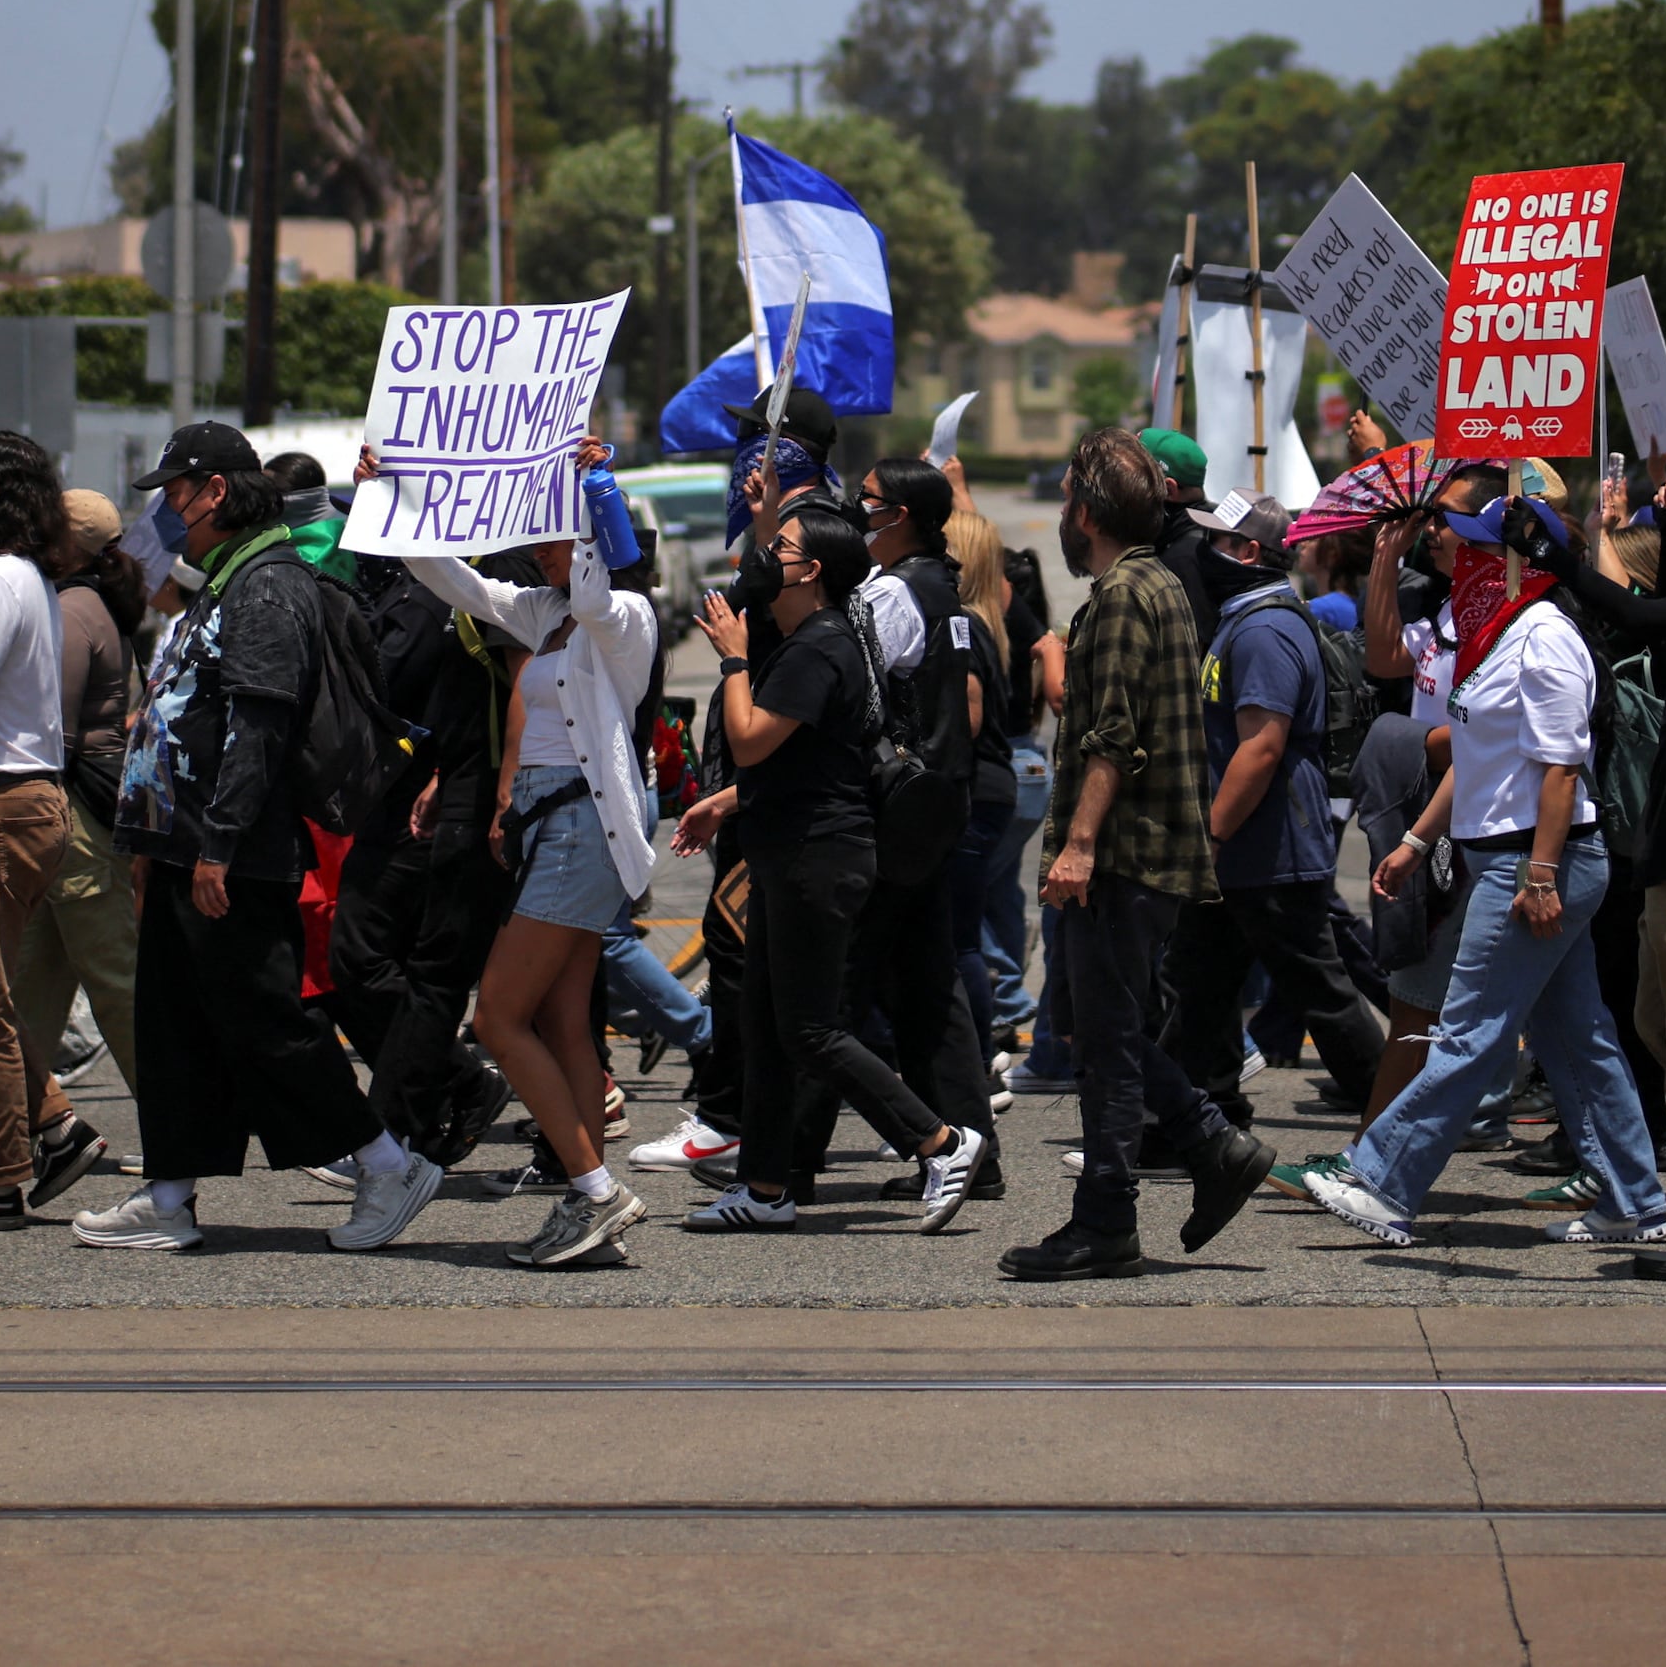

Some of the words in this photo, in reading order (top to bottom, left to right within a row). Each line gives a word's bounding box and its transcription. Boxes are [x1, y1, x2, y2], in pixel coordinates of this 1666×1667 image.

[1472, 197, 1510, 222] NO
[1520, 192, 1574, 219] ONE
[1581, 189, 1609, 215] IS
[1277, 264, 1319, 305] We
[1311, 217, 1354, 274] need
[1460, 220, 1603, 265] ILLEGAL
[1310, 265, 1374, 339] leaders
[1365, 227, 1397, 271] not
[1355, 307, 1391, 346] love
[1383, 264, 1430, 311] with
[1506, 272, 1545, 297] ON
[391, 309, 520, 374] STOP
[533, 300, 615, 374] THE
[1357, 332, 1418, 393] money
[1404, 305, 1434, 339] but
[1450, 300, 1594, 344] STOLEN
[382, 364, 601, 453] INHUMANE
[1379, 385, 1420, 427] love
[1445, 354, 1586, 409] LAND
[377, 451, 583, 542] TREATMENT
[403, 1155, 425, 1189] HOKA
